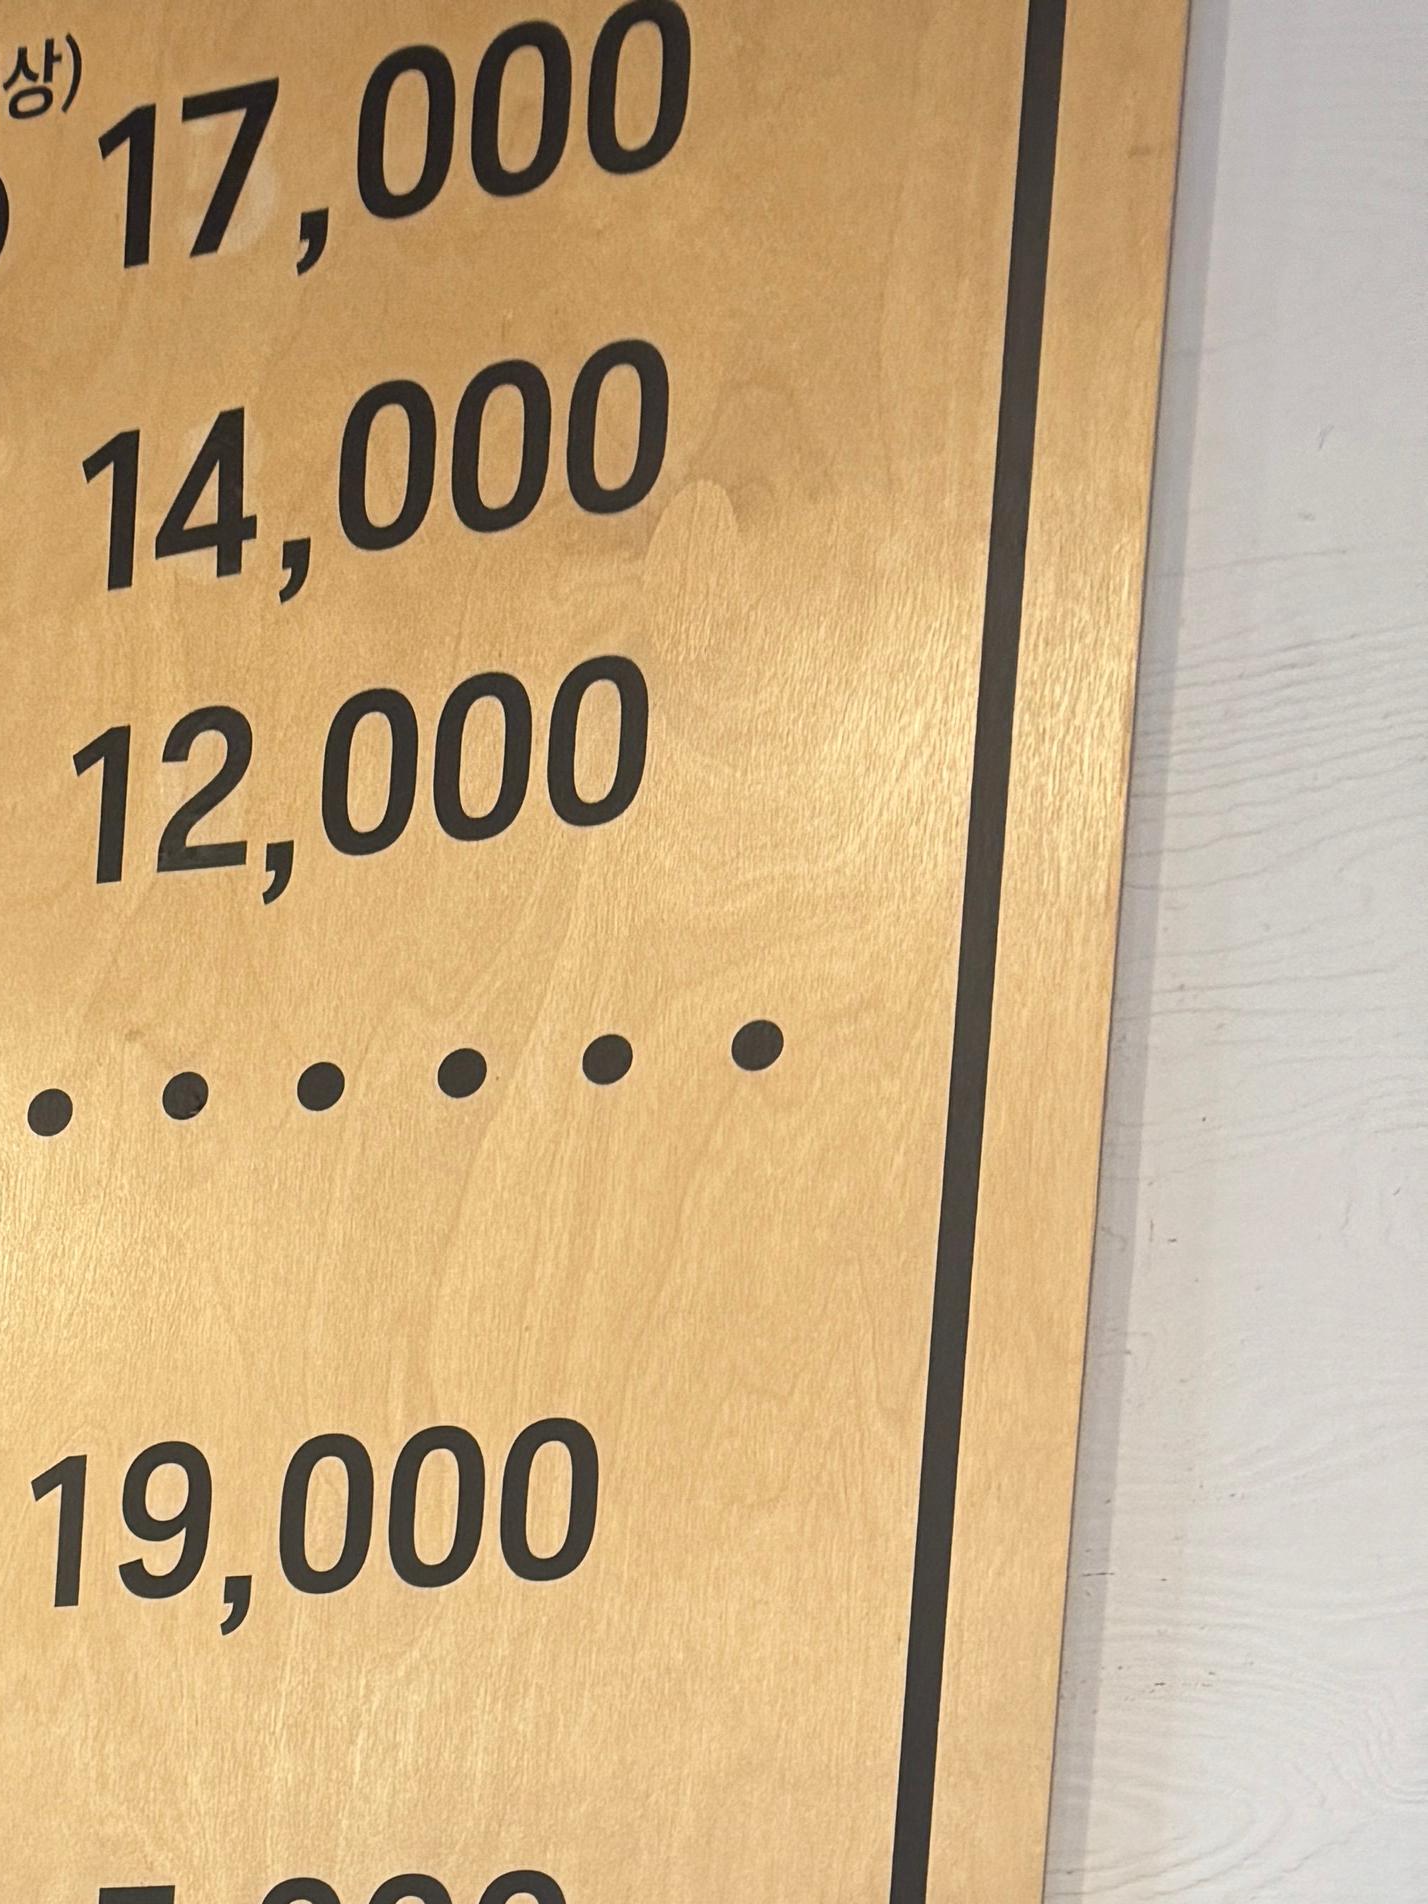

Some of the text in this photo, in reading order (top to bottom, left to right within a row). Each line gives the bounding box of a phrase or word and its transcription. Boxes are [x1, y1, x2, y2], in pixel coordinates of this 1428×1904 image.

[99, 0, 691, 275] 17,000
[83, 340, 669, 603] 14,000
[73, 656, 648, 904] 12,000
[32, 1418, 598, 1635] 19,000
